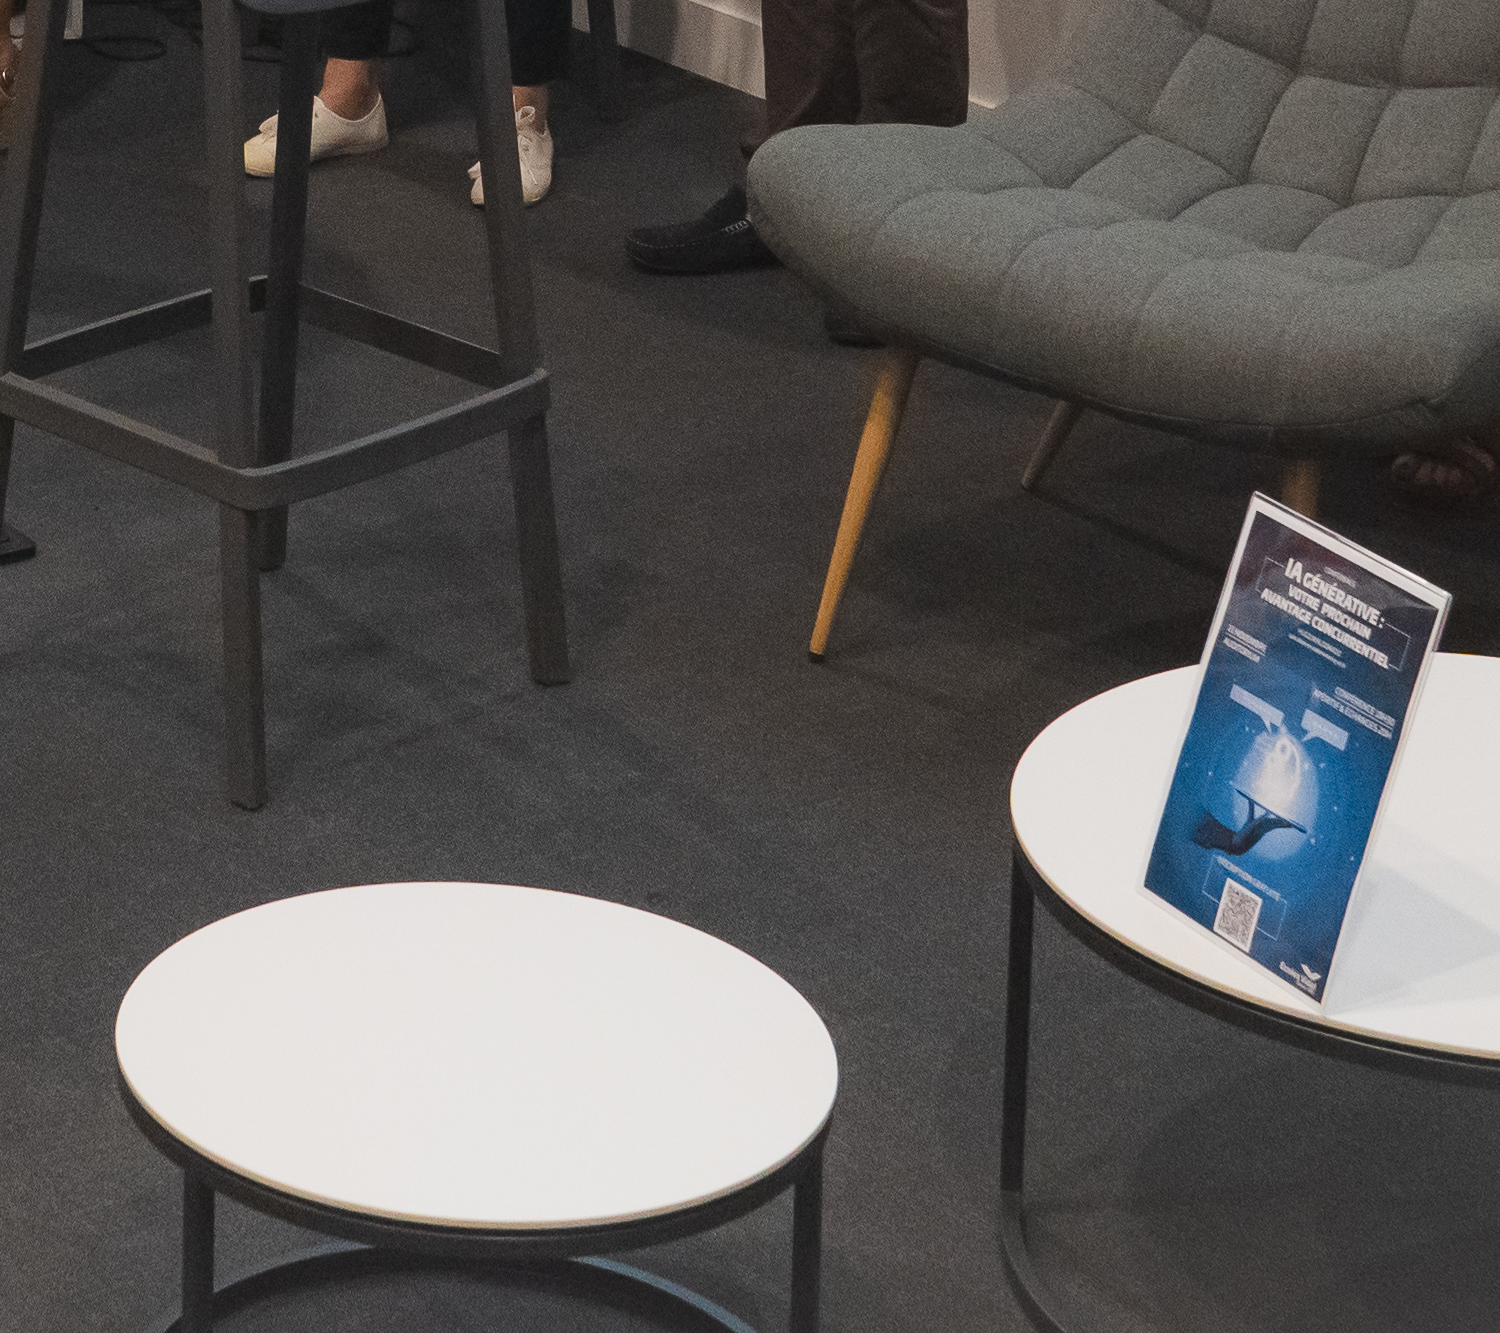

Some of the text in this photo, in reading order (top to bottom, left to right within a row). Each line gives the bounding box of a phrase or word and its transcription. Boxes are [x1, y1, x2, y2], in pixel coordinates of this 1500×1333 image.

[1284, 557, 1303, 584] IA
[1302, 572, 1381, 627] GÉNÉRATIVE
[1288, 583, 1371, 640] VOTRE PROCHAIN
[1261, 588, 1313, 624] AVANTAGE
[1311, 615, 1390, 669] CONCURRENTIEL
